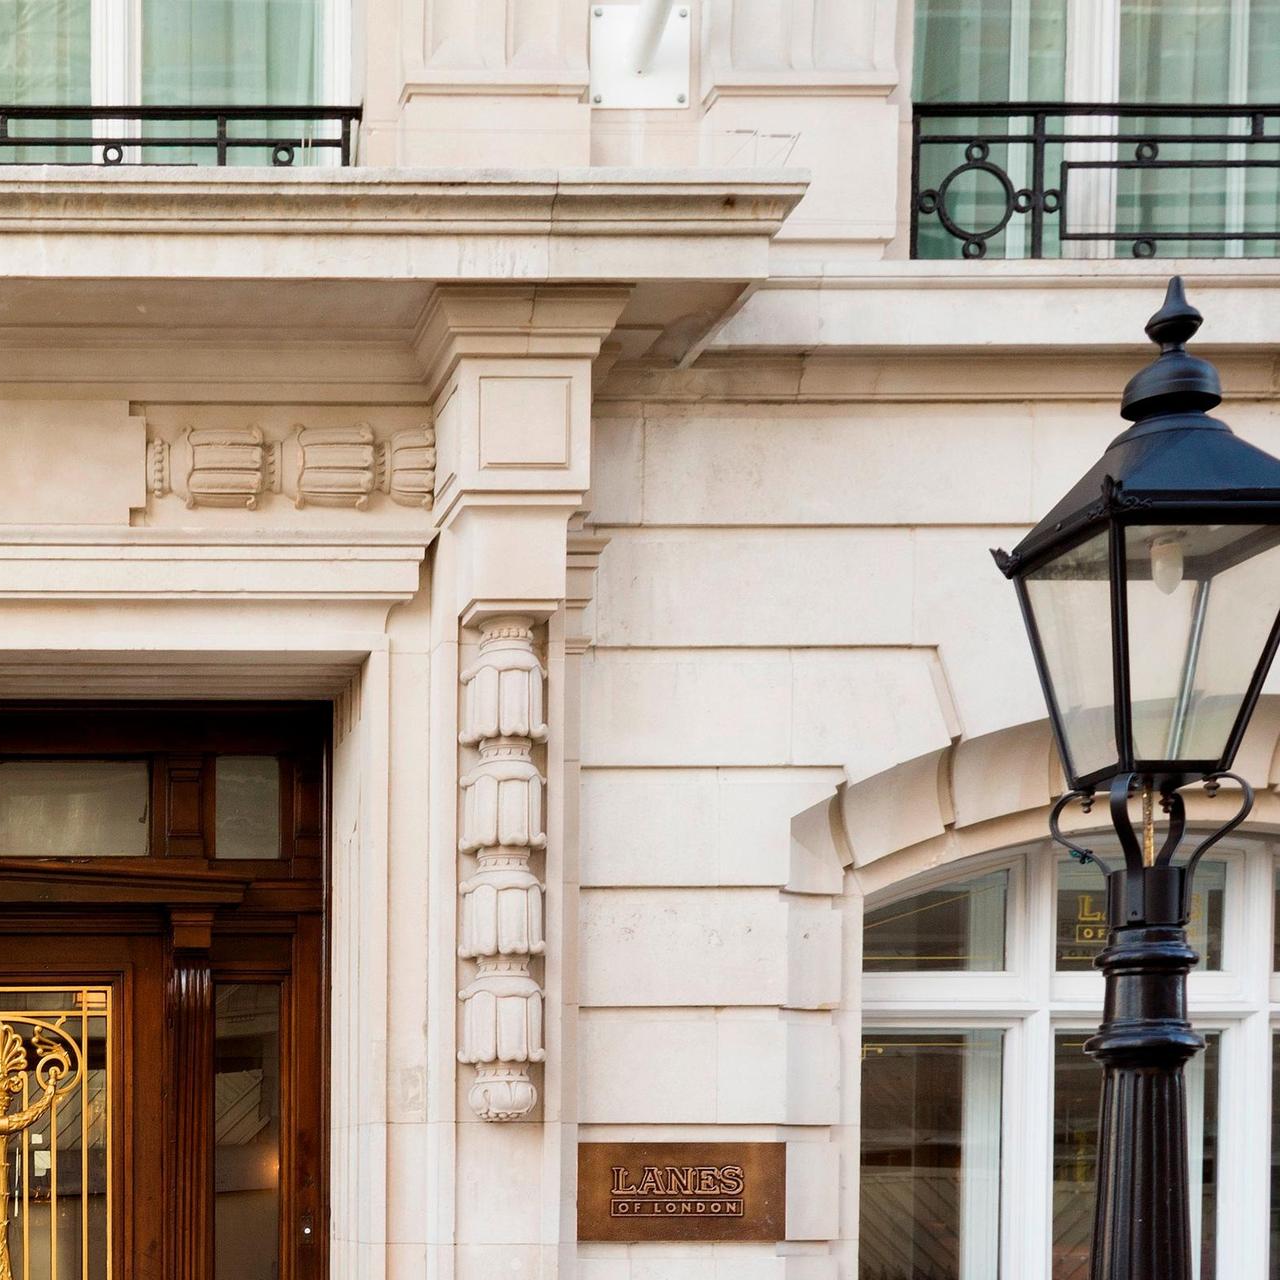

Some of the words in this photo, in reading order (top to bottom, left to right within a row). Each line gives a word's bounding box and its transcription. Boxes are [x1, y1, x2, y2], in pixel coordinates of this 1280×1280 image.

[611, 1165, 745, 1195] LANES
[618, 1202, 641, 1213] OF
[654, 1202, 737, 1213] LONDON
